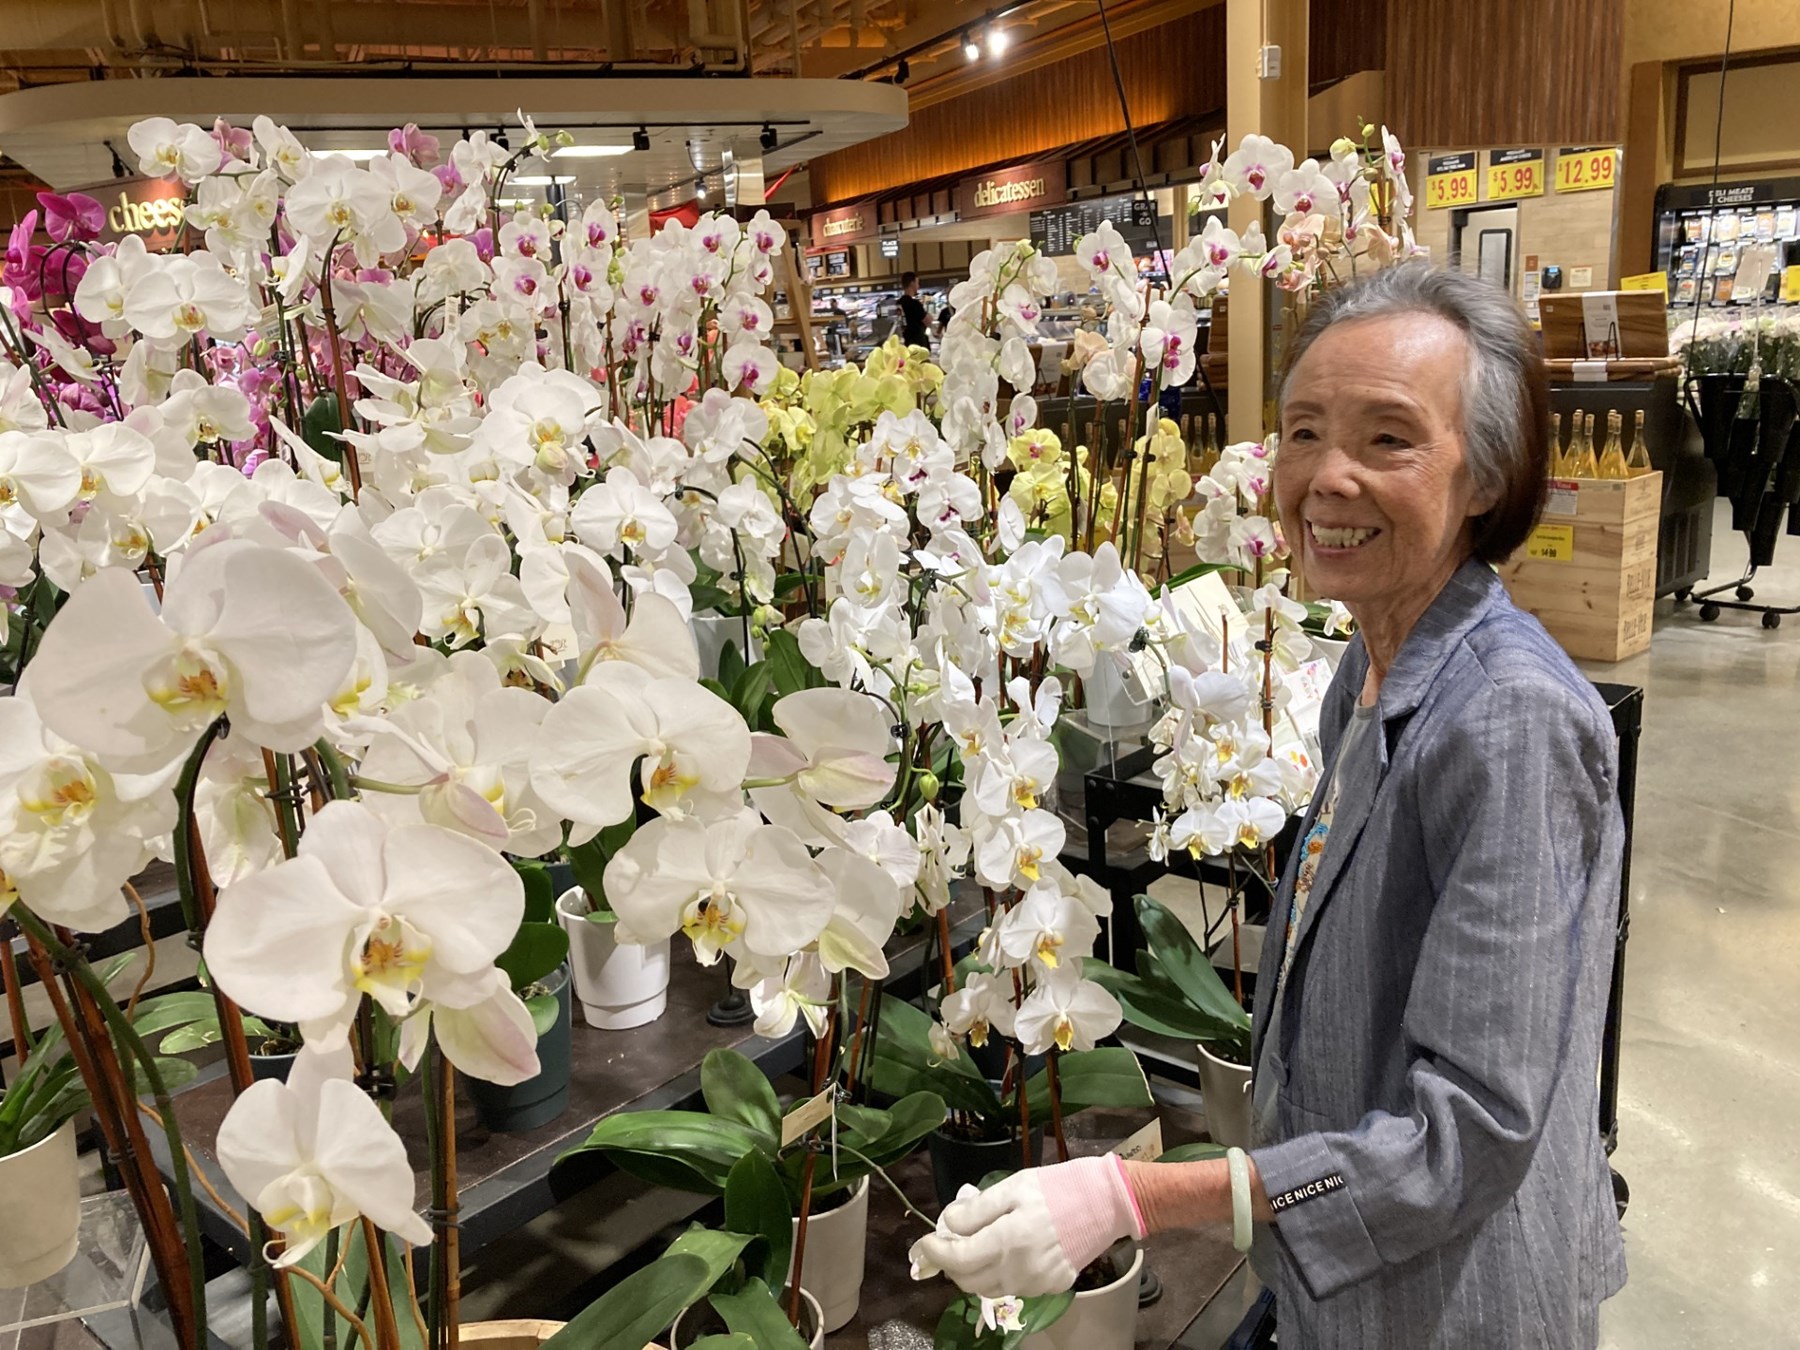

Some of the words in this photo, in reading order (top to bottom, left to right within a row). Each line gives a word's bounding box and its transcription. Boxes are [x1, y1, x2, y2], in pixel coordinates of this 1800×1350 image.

[1493, 166, 1533, 193] $5.99
[1558, 155, 1612, 184] $12.99
[974, 178, 1045, 208] delicatessen
[1431, 176, 1468, 201] $5.99
[1717, 194, 1753, 204] CHEESES
[1728, 186, 1755, 195] MEATS
[108, 191, 185, 233] chees
[1139, 217, 1152, 226] GO
